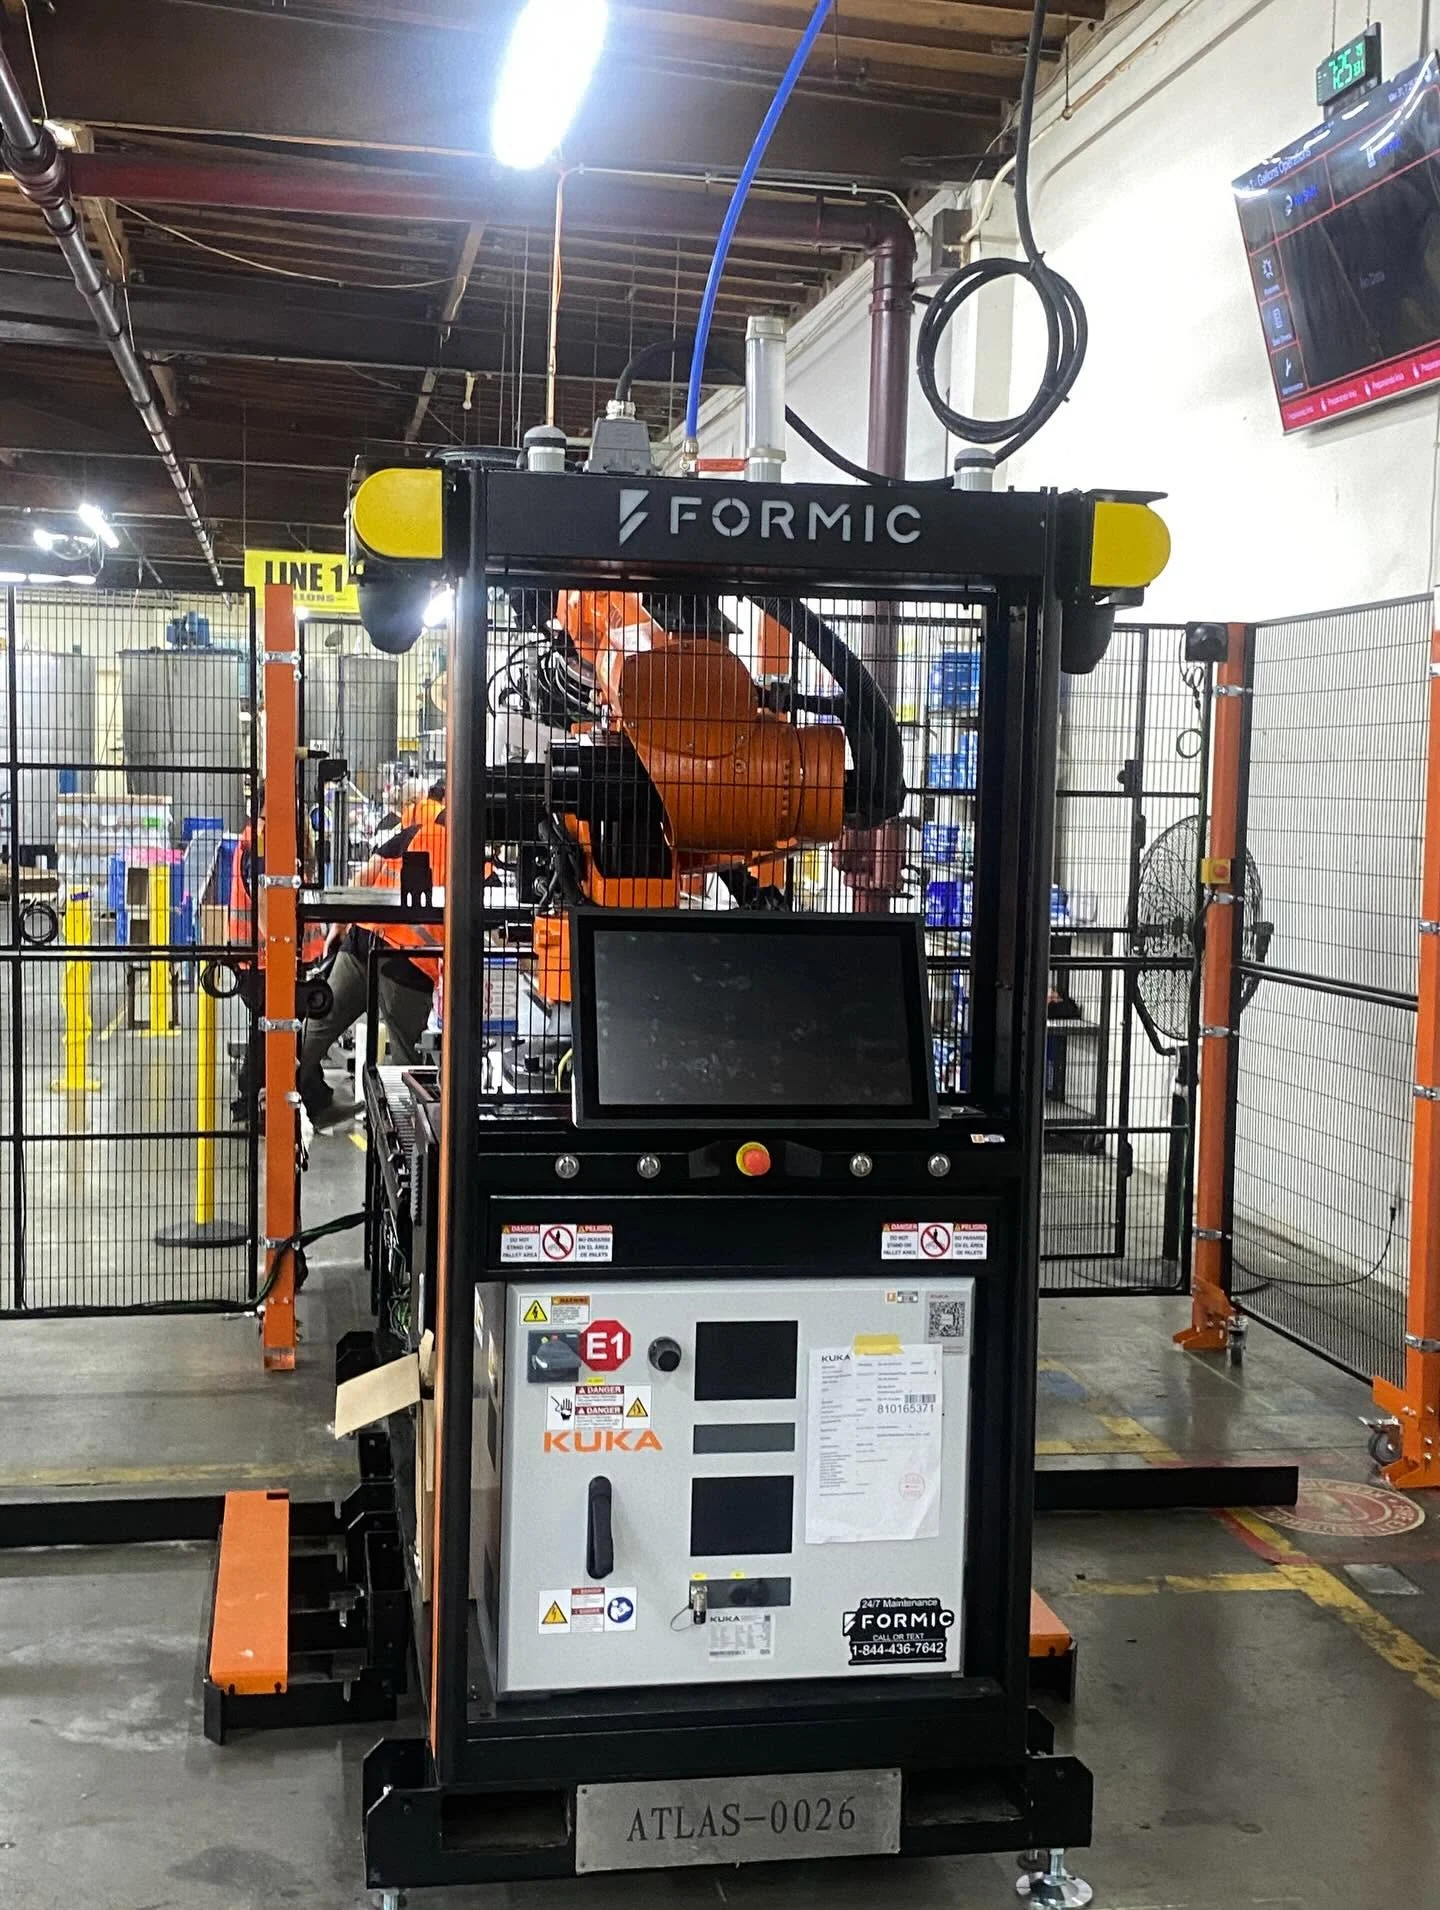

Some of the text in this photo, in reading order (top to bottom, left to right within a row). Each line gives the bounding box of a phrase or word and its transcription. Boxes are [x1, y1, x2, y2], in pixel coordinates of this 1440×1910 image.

[670, 496, 922, 544] FORMIC
[265, 561, 343, 593] LINE 1
[587, 1331, 624, 1360] E1
[821, 1354, 850, 1362] KUKA
[587, 1386, 621, 1394] DANGER
[877, 1404, 934, 1414] 810165371
[544, 1429, 663, 1453] KUKA
[861, 1599, 938, 1609] 24/7 Maintenance
[710, 1615, 741, 1623] KUKA
[861, 1611, 953, 1629] FORMIC
[872, 1632, 925, 1641] CALL OR TEXT
[852, 1642, 944, 1656] 1-844-436-7642
[627, 1796, 856, 1842] ATLAS-0026
